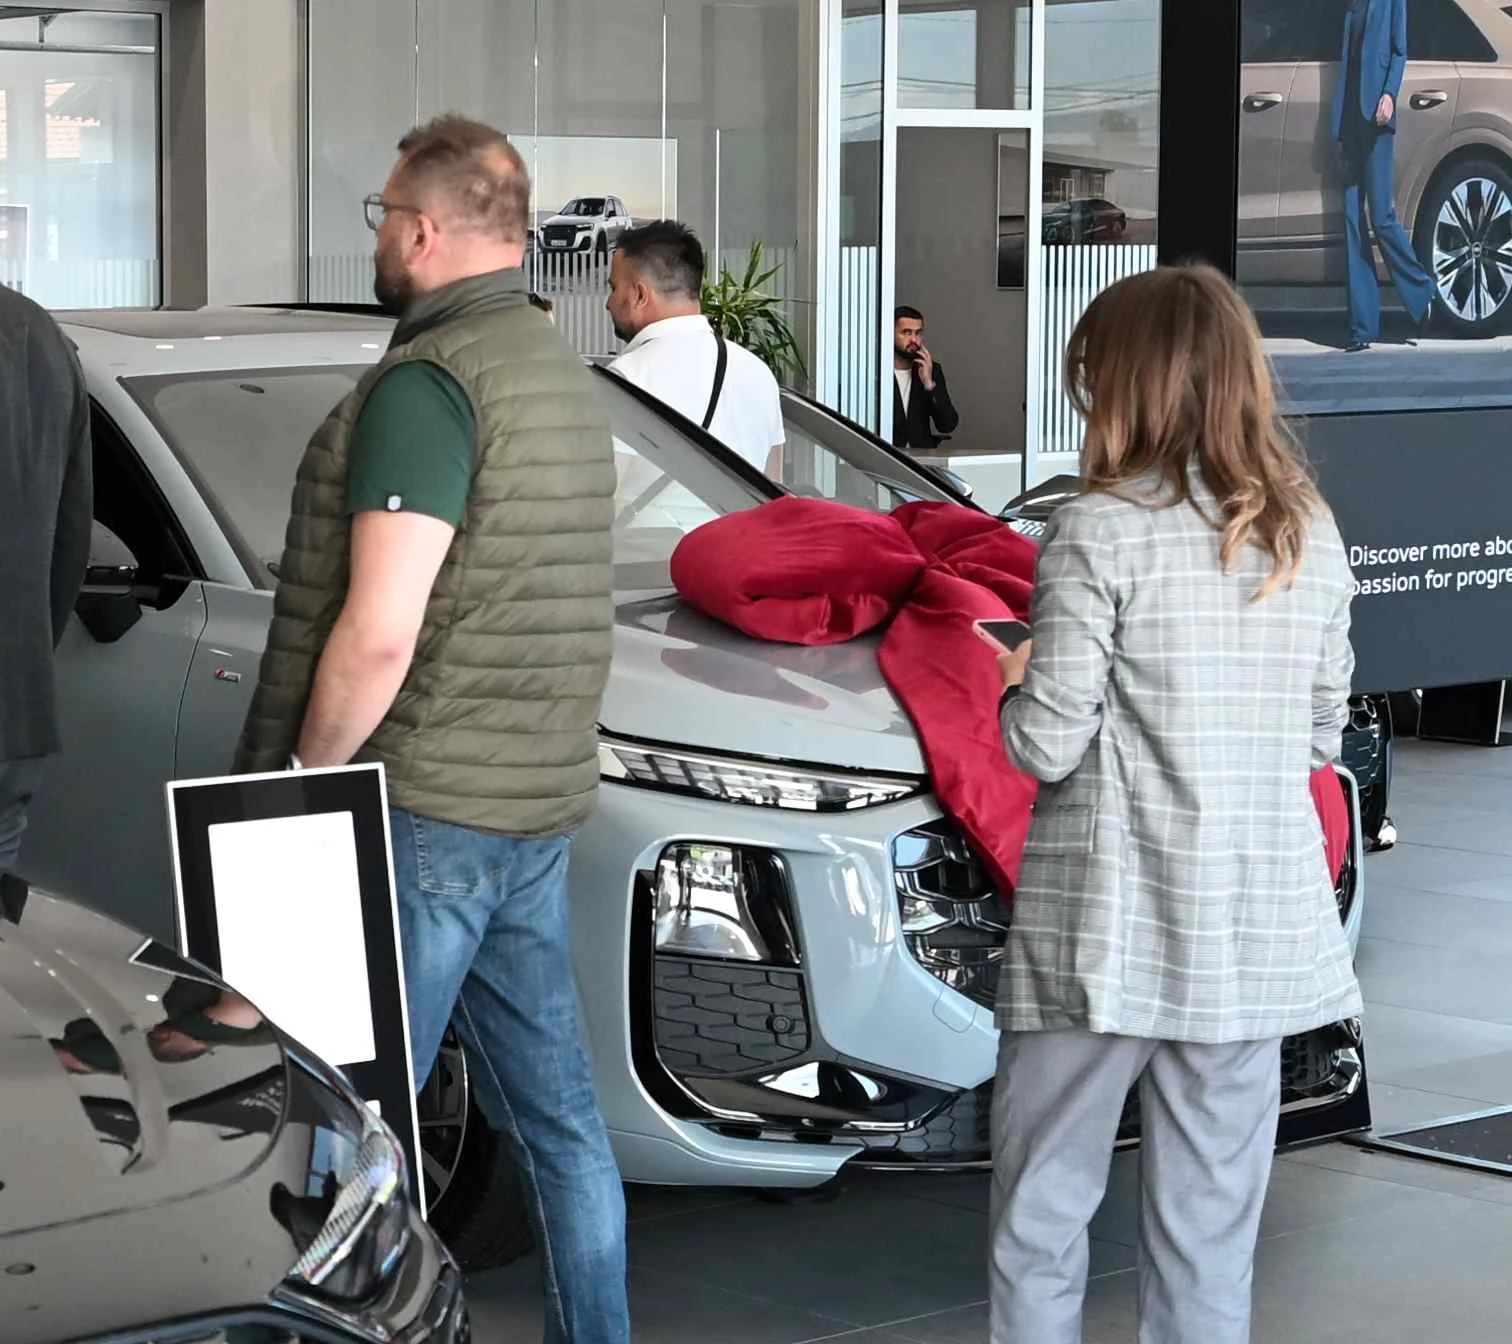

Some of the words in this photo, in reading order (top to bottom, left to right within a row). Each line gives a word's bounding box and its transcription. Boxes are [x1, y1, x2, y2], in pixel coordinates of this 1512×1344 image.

[1350, 545, 1428, 567] Discover
[1432, 543, 1481, 561] more
[1424, 568, 1453, 590] for
